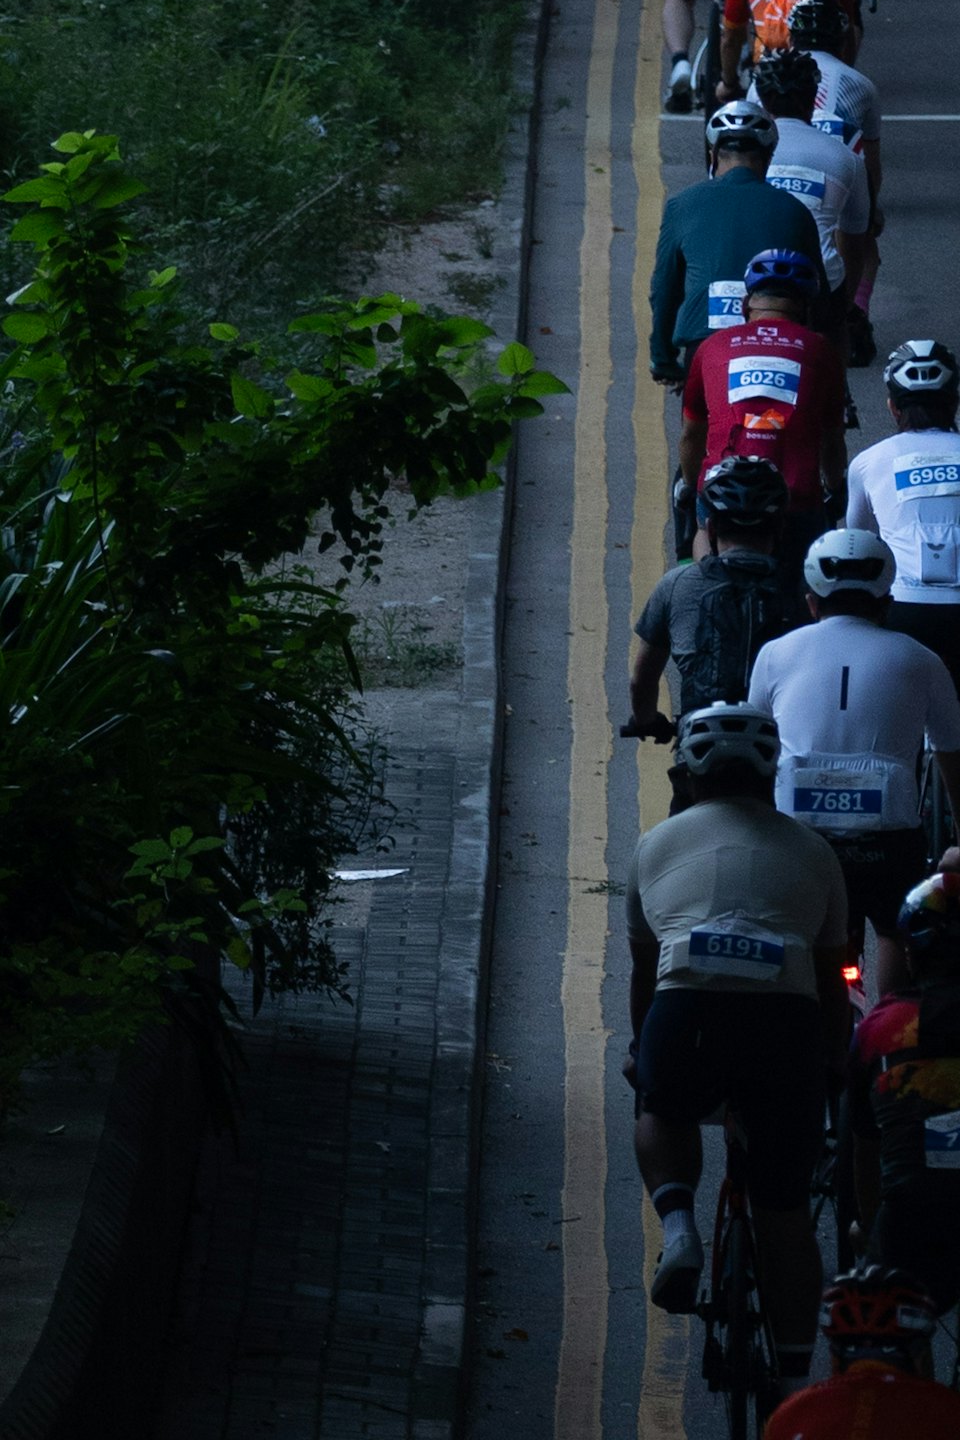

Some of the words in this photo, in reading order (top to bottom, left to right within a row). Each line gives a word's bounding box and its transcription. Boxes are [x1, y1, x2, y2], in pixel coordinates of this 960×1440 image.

[740, 371, 786, 387] 6026
[908, 466, 959, 484] 6968
[810, 791, 864, 811] 7681
[706, 935, 764, 960] 6191
